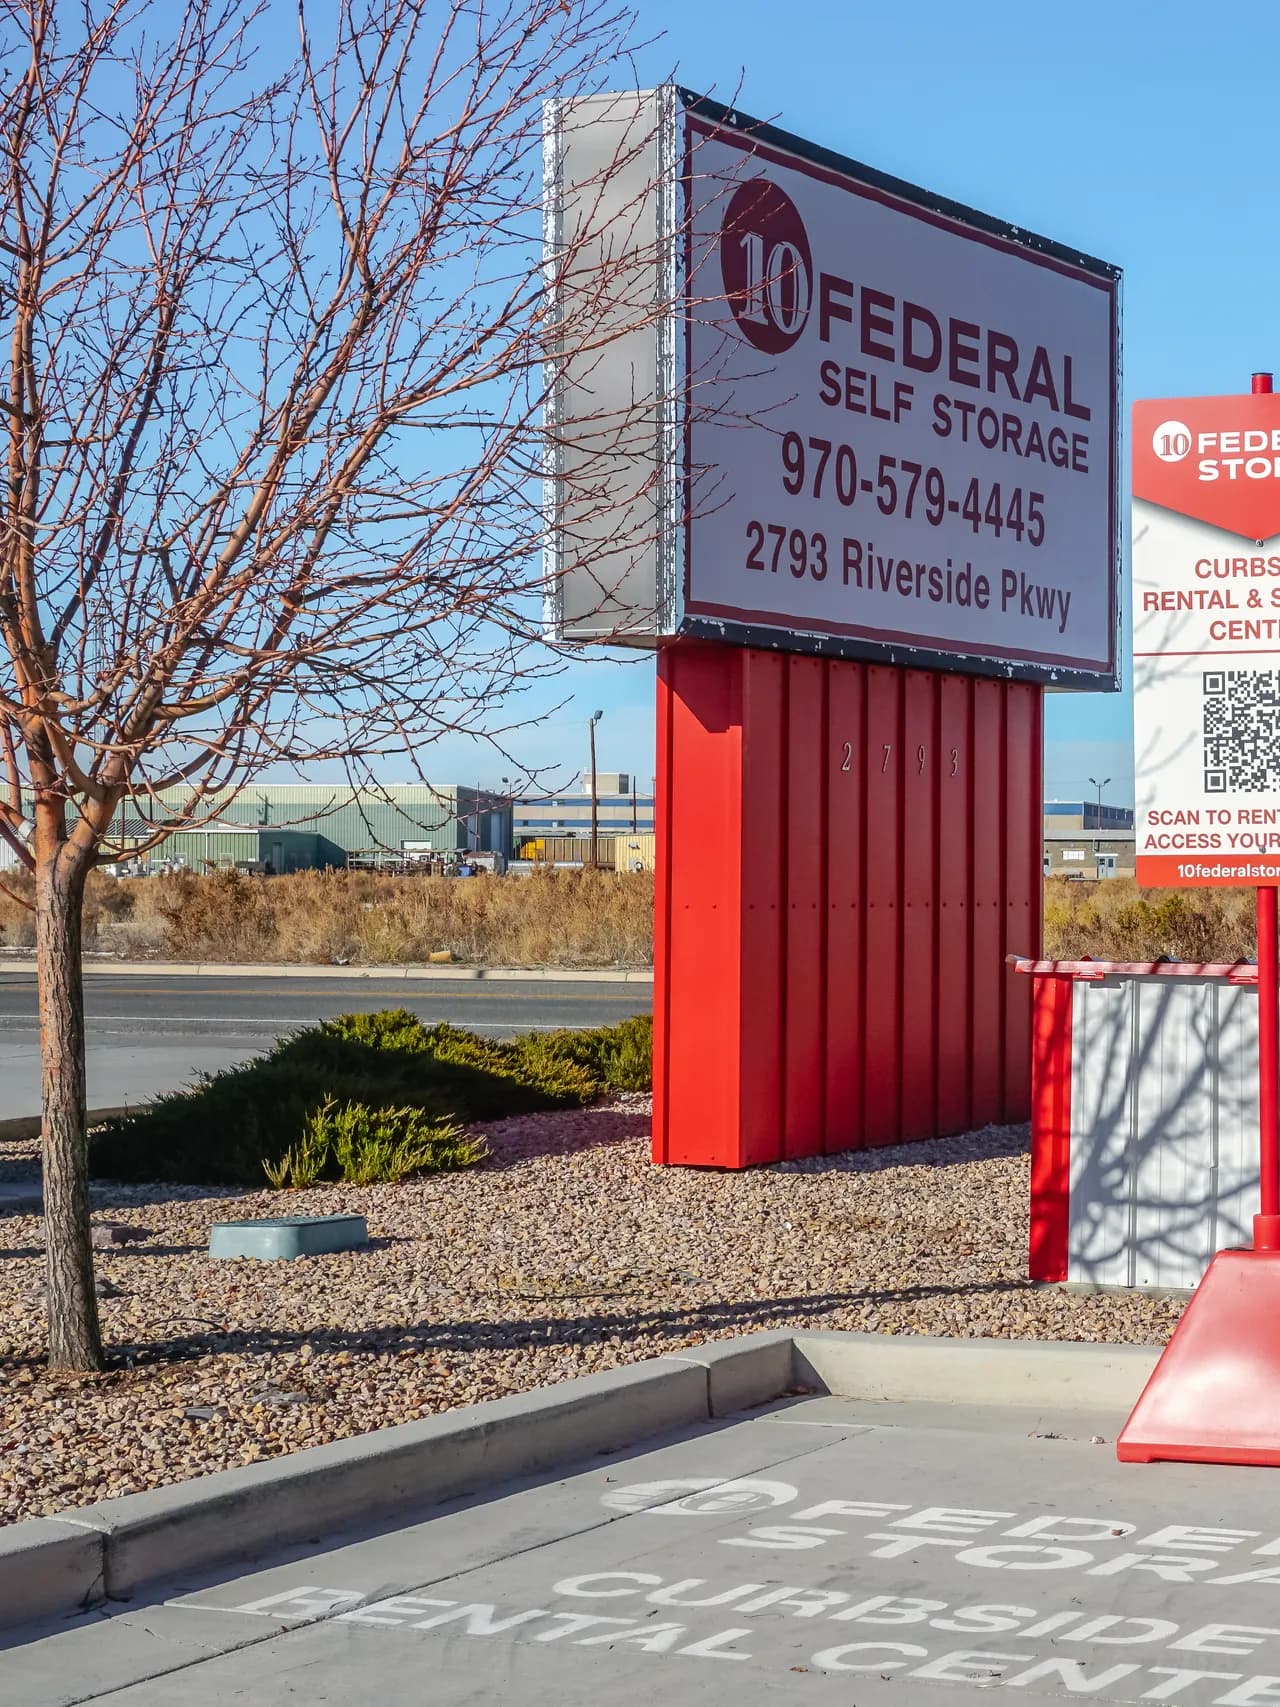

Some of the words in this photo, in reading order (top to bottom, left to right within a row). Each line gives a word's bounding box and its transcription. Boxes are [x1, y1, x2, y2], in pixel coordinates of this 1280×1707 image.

[736, 232, 804, 336] 10
[818, 272, 1092, 422] FEDERAL
[818, 360, 915, 424] SELF
[931, 394, 1090, 474] STORAGE
[1158, 431, 1191, 458] 10
[781, 430, 1046, 547] 970-579-4445
[745, 520, 829, 582] 2793
[842, 537, 992, 612] Riverside
[1000, 568, 1072, 634] Pkwy
[1143, 590, 1239, 611] RENTAL
[1247, 588, 1263, 609] &
[841, 742, 959, 777] 2793
[1144, 833, 1222, 850] ACCESS
[1147, 809, 1201, 826] SCAN
[1205, 809, 1232, 825] TO
[235, 1586, 754, 1660] RENTAL
